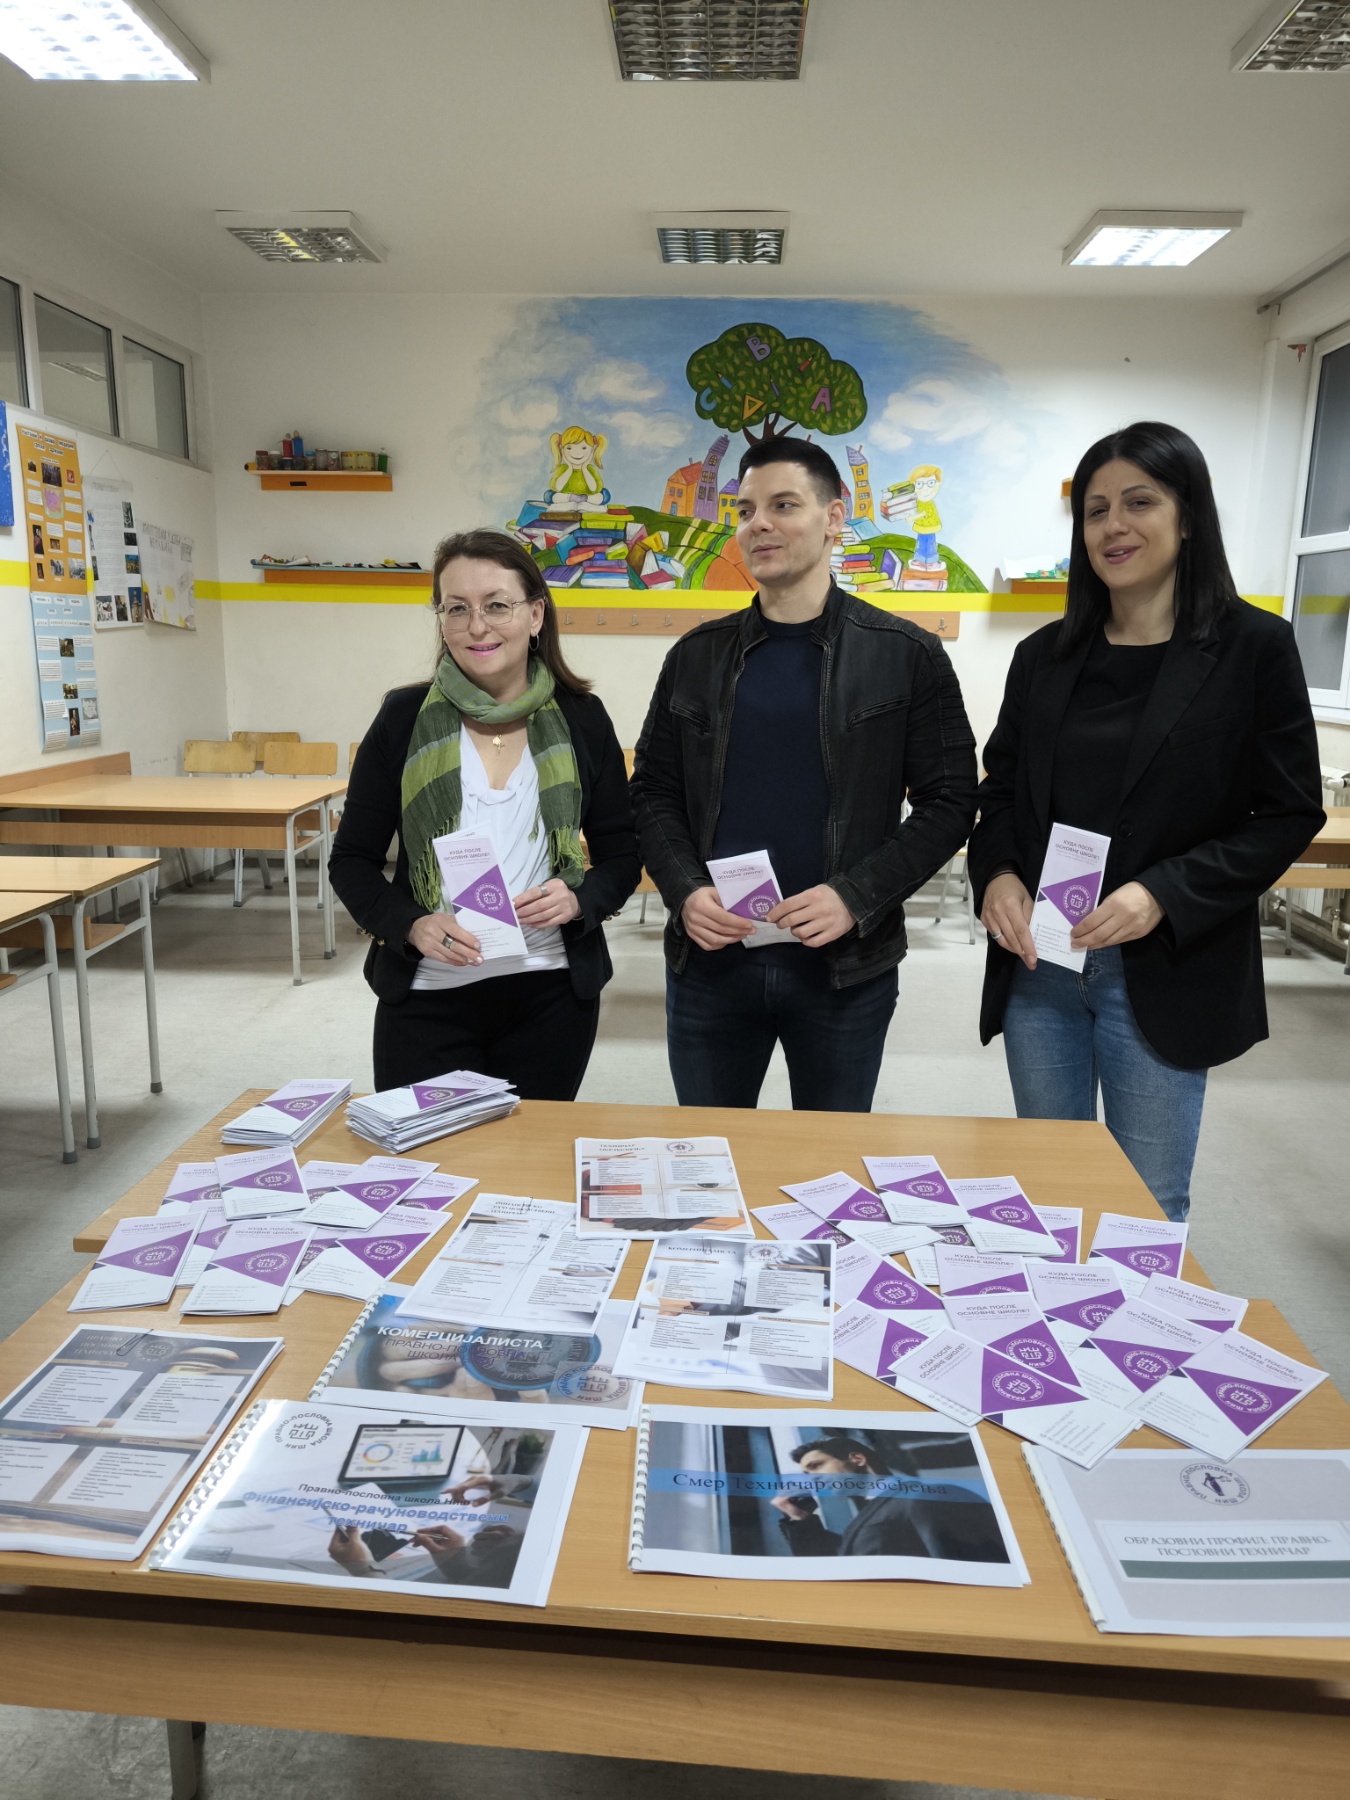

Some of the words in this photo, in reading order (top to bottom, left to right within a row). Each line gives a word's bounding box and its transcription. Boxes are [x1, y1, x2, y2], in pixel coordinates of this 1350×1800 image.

[810, 386, 832, 413] A
[1055, 844, 1079, 853] ОСНОВНЕ
[1078, 844, 1093, 852] ПОСЛЕ
[1154, 1287, 1194, 1302] ОСНОВНЕ
[1168, 1286, 1190, 1296] КУДА
[1193, 1294, 1221, 1306] ПОСЛЕ
[839, 1316, 858, 1328] ПОСЛЕ
[1126, 1311, 1165, 1330] ОСНОВНЕ
[1141, 1312, 1163, 1324] КУДА
[1165, 1323, 1194, 1336] ПОСЛЕ
[378, 1327, 543, 1348] КОМЕРЦИЈАЛИСТА
[407, 1351, 458, 1361] ШКОЛА
[919, 1359, 934, 1369] КУДА
[934, 1345, 952, 1359] ПОСЛЕ
[1224, 1343, 1267, 1365] ОСНОВНЕ
[1240, 1346, 1261, 1359] КУДА
[1264, 1358, 1294, 1373] ПОСЛЕ
[920, 1359, 945, 1379] ОСНОВНЕ
[673, 1473, 724, 1490] Смер
[731, 1476, 825, 1492] Техничар
[832, 1478, 947, 1495] обезбеђења
[1183, 1465, 1232, 1499] ПРАВНО-ПОСЛОВНА
[1234, 1477, 1247, 1498] ШКОЛА
[299, 1483, 401, 1502] Правно-пословна
[404, 1495, 442, 1505] школа
[242, 1492, 509, 1523] Финансијско-рачуноводствени
[327, 1515, 408, 1534] техничар
[1124, 1536, 1204, 1545] ОБРАЗОВНИ
[1207, 1537, 1267, 1545] ПРОФИЛ:
[1272, 1536, 1332, 1545] ПРАВНО-
[1157, 1548, 1235, 1557] ПОСЛОВНИ
[1239, 1548, 1311, 1556] ТЕХНИЧАР
